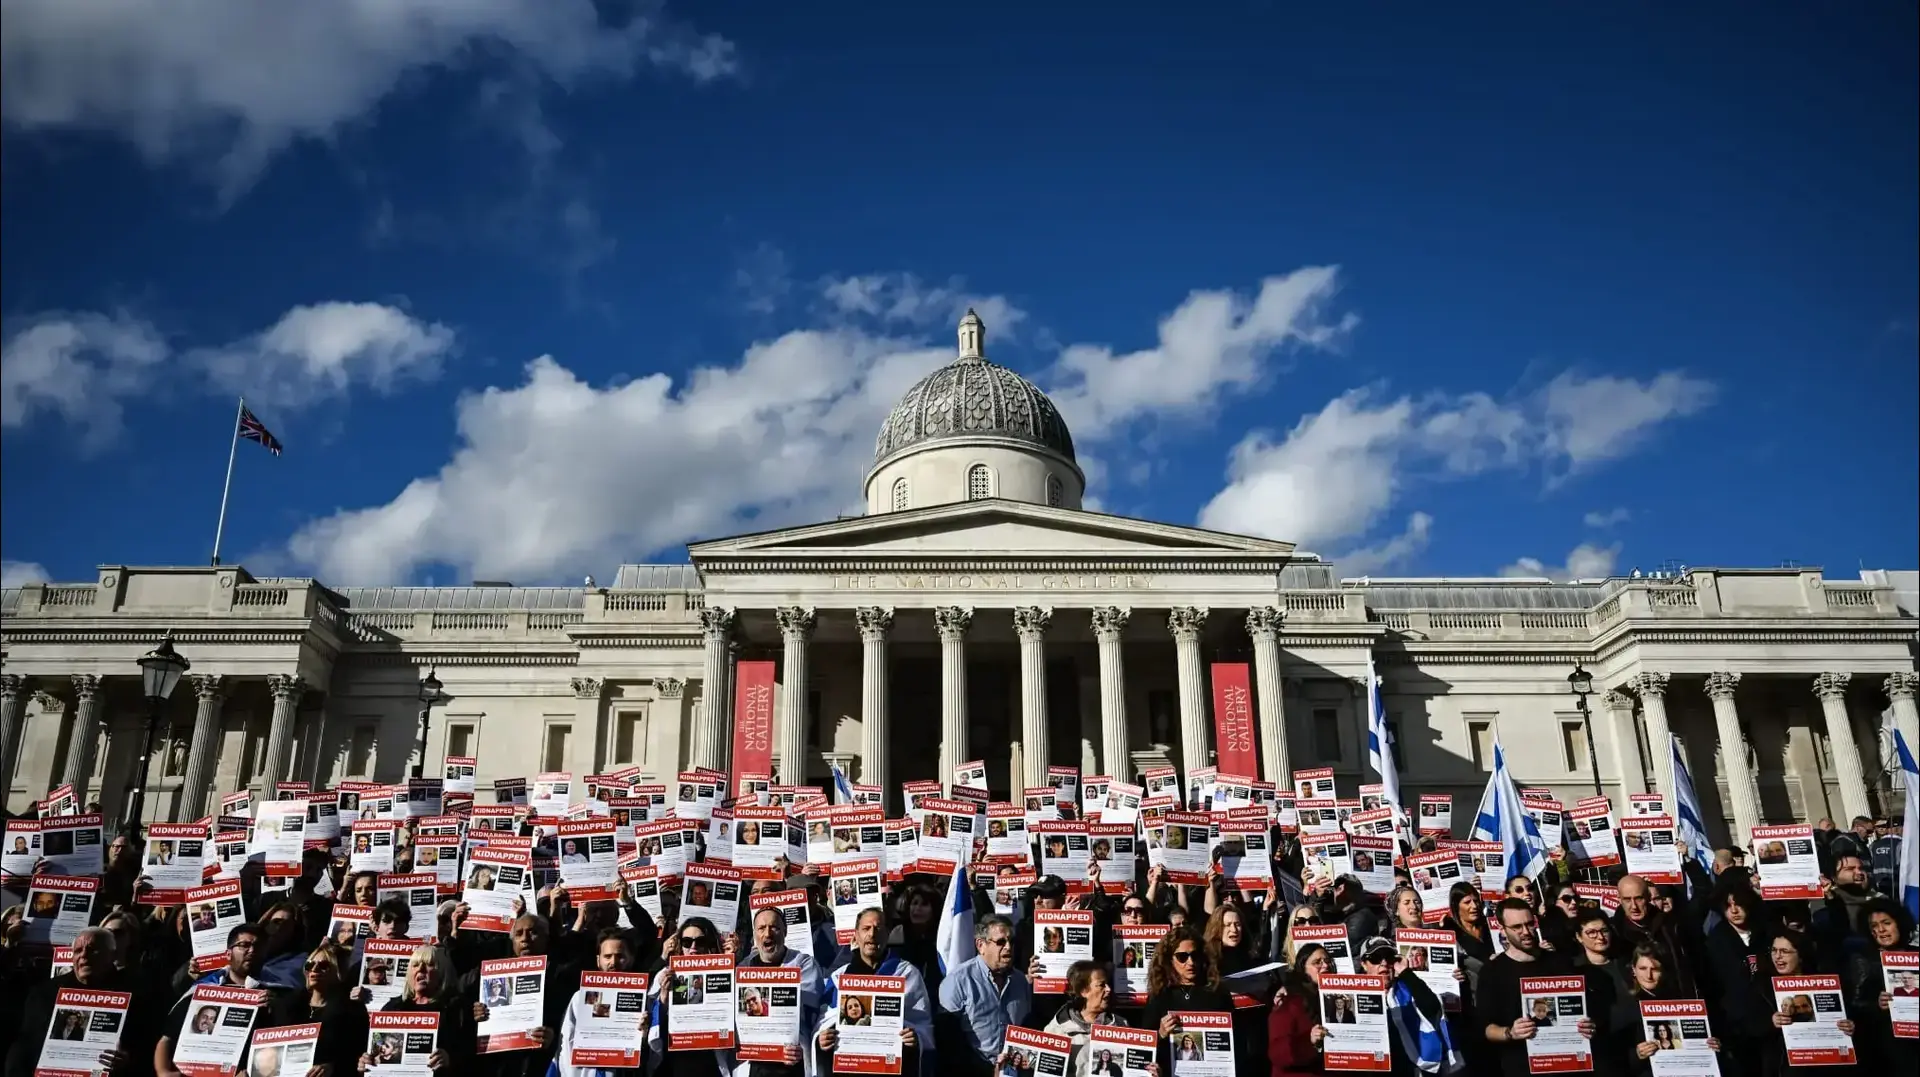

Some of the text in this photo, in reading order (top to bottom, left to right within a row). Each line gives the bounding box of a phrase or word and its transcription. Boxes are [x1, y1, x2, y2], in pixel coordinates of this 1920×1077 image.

[829, 576, 1153, 589] THE NATIONAL GALLERY
[744, 684, 757, 750] NATIONAL
[756, 684, 770, 751] GALLERY
[1224, 684, 1238, 752] NATIONAL
[1234, 685, 1250, 752] GALLERY
[808, 807, 851, 816] KIDNAPPED
[926, 801, 973, 812] KIDNAPPED
[44, 816, 100, 826] KIDNAPPED
[833, 814, 881, 823] KIDNAPPED
[1167, 813, 1209, 823] KIDNAPPED
[1351, 811, 1390, 821] KIDNAPPED
[561, 822, 613, 831] KIDNAPPED
[637, 822, 680, 834] KIDNAPPED
[1622, 819, 1671, 827] KIDNAPPED
[1754, 827, 1809, 836] KIDNAPPED
[1303, 835, 1344, 843] KIDNAPPED
[1353, 838, 1392, 846] KIDNAPPED
[475, 850, 526, 861] KIDNAPPED
[1410, 852, 1456, 865] KIDNAPPED
[689, 866, 739, 878] KIDNAPPED
[833, 862, 876, 873] KIDNAPPED
[35, 878, 94, 888] KIDNAPPED
[380, 875, 434, 885] KIDNAPPED
[188, 885, 238, 899] KIDNAPPED
[753, 893, 804, 905] KIDNAPPED
[335, 907, 372, 916] KIDNAPP
[1038, 913, 1090, 921] KIDNAPPED
[1294, 928, 1344, 937] KIDNAPPED
[1400, 932, 1452, 941] KIDNAPPED
[368, 942, 422, 951] KIDNAPPE
[485, 960, 543, 971] KIDNAPPED
[673, 958, 731, 967] KIDNAPPED
[586, 975, 644, 984] KIDNAPPED
[739, 971, 797, 979] KIDNAPPED
[842, 978, 901, 988] KIDNAPPED
[1322, 978, 1380, 986] KIDNAPPED
[1524, 981, 1581, 990] KIDNAPPED
[1777, 979, 1836, 988] KIDNAPPED
[60, 992, 125, 1004] KIDNAPPED
[198, 988, 259, 1002] KIDNAPPED
[374, 1016, 435, 1024] KIDNAPPED
[1180, 1016, 1228, 1024] IDNAPPED
[256, 1027, 316, 1040] KIDNAPPED
[1095, 1029, 1153, 1042] KIDNAPPED
[1010, 1030, 1067, 1048] KIDNAPPED
